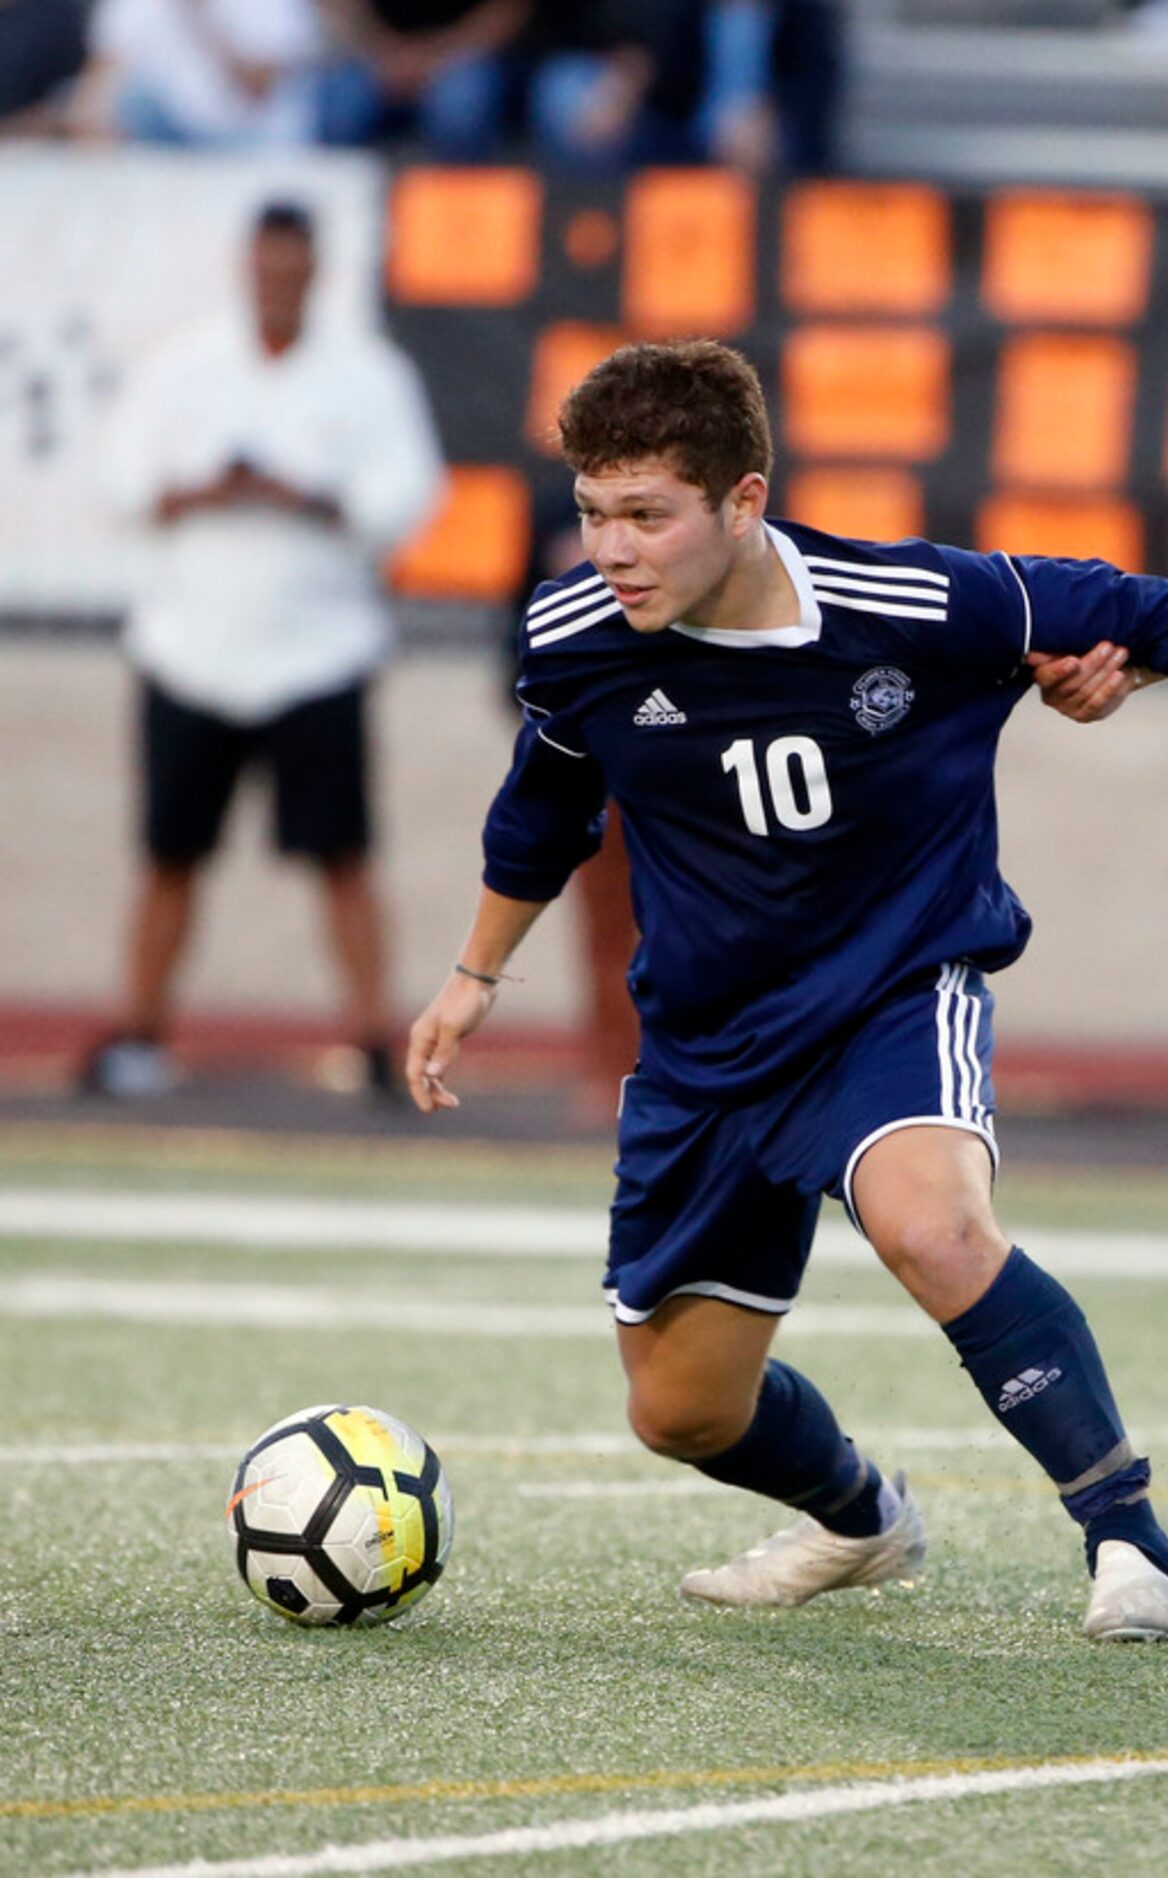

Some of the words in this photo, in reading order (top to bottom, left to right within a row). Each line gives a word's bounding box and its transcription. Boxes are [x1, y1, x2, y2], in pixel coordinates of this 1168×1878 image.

[633, 711, 687, 726] adidas
[721, 735, 833, 837] 10
[998, 1367, 1062, 1412] adidas
